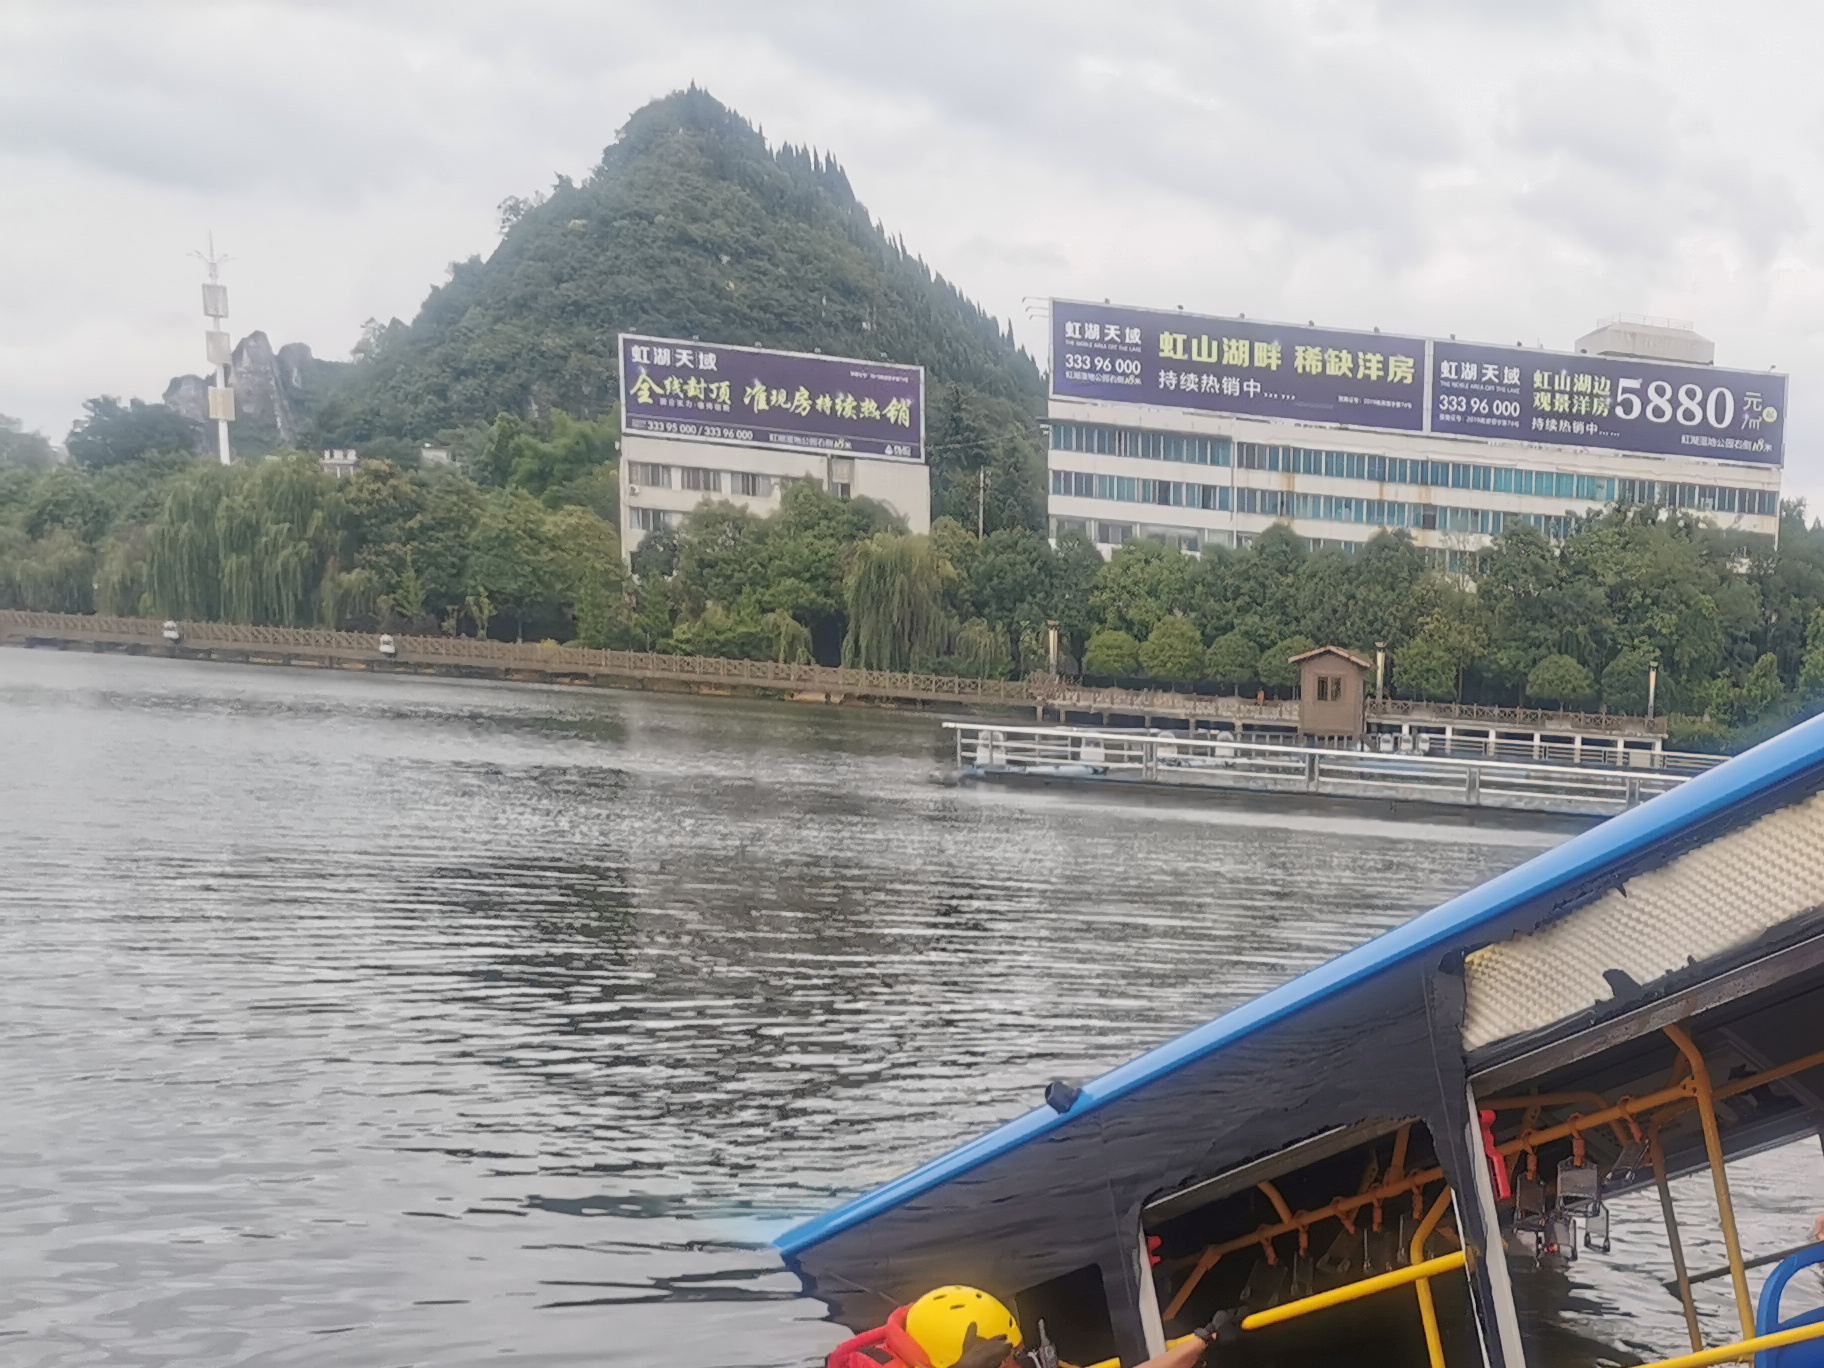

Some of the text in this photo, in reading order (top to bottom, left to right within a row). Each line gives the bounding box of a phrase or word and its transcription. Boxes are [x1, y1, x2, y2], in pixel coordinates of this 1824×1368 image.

[1065, 321, 1141, 344] 虹湖天域
[630, 344, 717, 371] 虹湖天域
[1065, 354, 1141, 375] 333 96 000
[1159, 331, 1415, 384] 虹山湖畔 稀缺洋房
[1440, 360, 1520, 385] 虹湖天域
[1533, 369, 1611, 396] 虹山湖边
[630, 374, 731, 405] 全线封顶
[1743, 392, 1762, 411] 元
[1439, 395, 1520, 417] 333 96 000
[1532, 391, 1611, 417] 观景洋房
[1615, 378, 1735, 429] 5880
[647, 420, 664, 431] 333
[666, 422, 677, 432] 95
[680, 423, 697, 434] 000
[704, 426, 721, 436] 333
[723, 428, 734, 438] 96
[736, 429, 753, 440] 000
